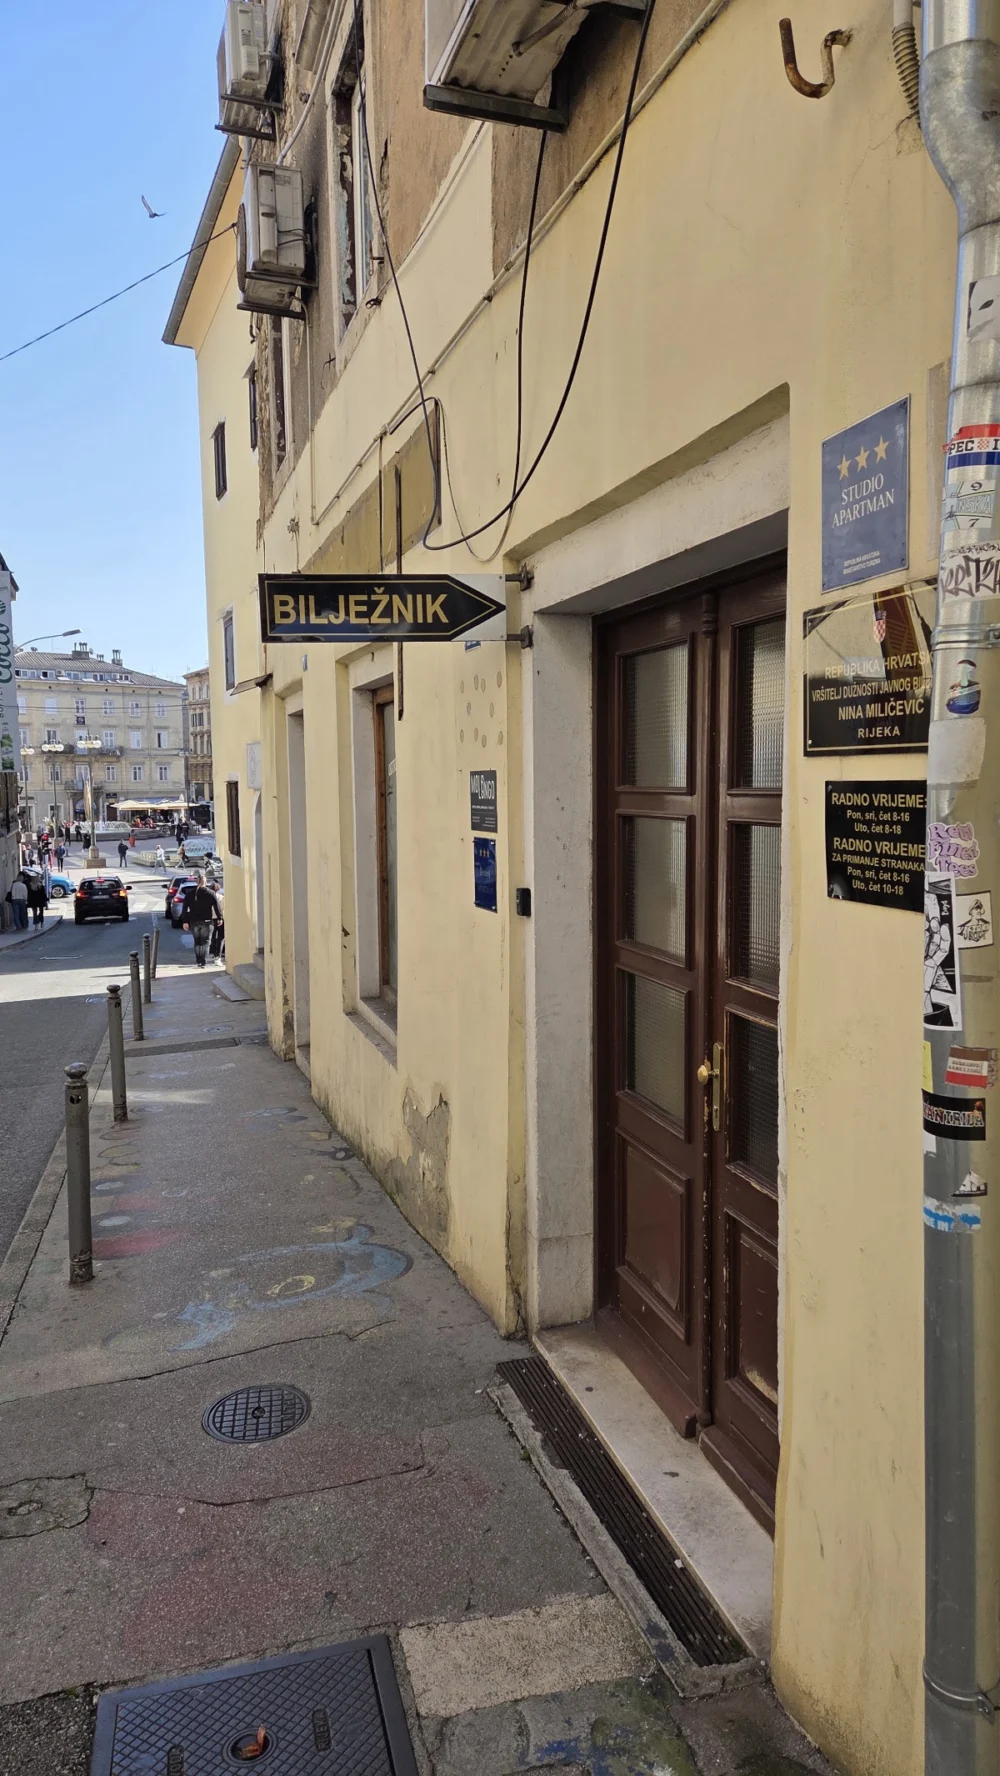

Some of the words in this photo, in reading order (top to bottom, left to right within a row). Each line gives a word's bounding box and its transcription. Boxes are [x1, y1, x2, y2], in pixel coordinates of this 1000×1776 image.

[841, 473, 884, 506] STUDIO
[832, 489, 895, 529] APARTMAN
[272, 586, 449, 625] BILJEŽNIK
[825, 659, 881, 680] REPUBLIKA
[812, 684, 842, 702] VRŠITELJ
[843, 680, 879, 699] DUŽNOSTI
[880, 678, 911, 695] JAVNOG
[838, 706, 863, 721] NINA
[865, 696, 925, 719] MILIČEVIĆ
[857, 726, 901, 739] RIJEKA
[831, 792, 870, 807] RADNO
[847, 810, 864, 822] Pon,
[865, 811, 876, 822] sri,
[879, 811, 892, 821] čet
[892, 811, 910, 822] 8-16
[854, 822, 870, 834] Uto,
[871, 823, 884, 833] čet
[884, 824, 902, 835] 8-18
[833, 837, 872, 853] RADNO
[832, 853, 842, 862] ZA
[842, 854, 880, 867] PRIMANJE
[881, 857, 926, 872] STRANAKA
[847, 867, 864, 879] Pon,
[865, 868, 876, 880] sri,
[879, 870, 892, 881] čet
[892, 872, 910, 883] 8-16
[852, 880, 868, 892] Uto,
[869, 881, 881, 892] čet
[883, 884, 904, 896] 10-18
